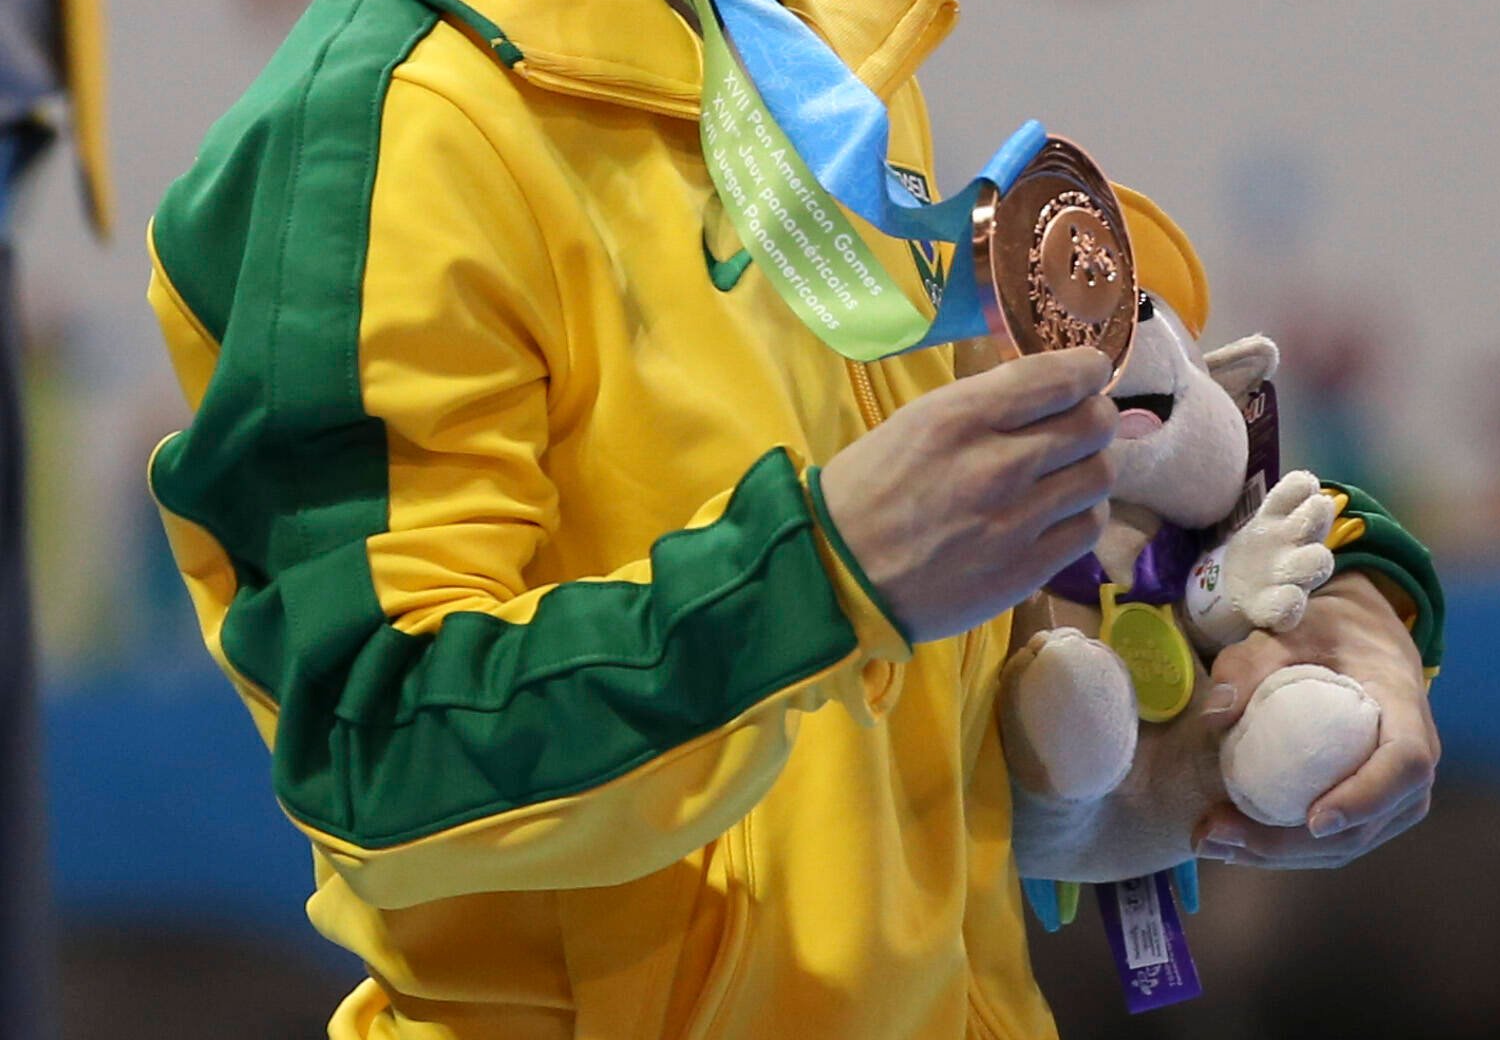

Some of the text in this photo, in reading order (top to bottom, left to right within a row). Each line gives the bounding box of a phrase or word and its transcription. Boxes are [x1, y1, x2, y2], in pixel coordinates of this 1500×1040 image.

[712, 147, 748, 207] Juegos
[743, 203, 841, 331] Panamericanos
[723, 69, 883, 296] XVII Pan American Games
[738, 144, 765, 187] Jeux
[758, 187, 859, 311] panaméricains
